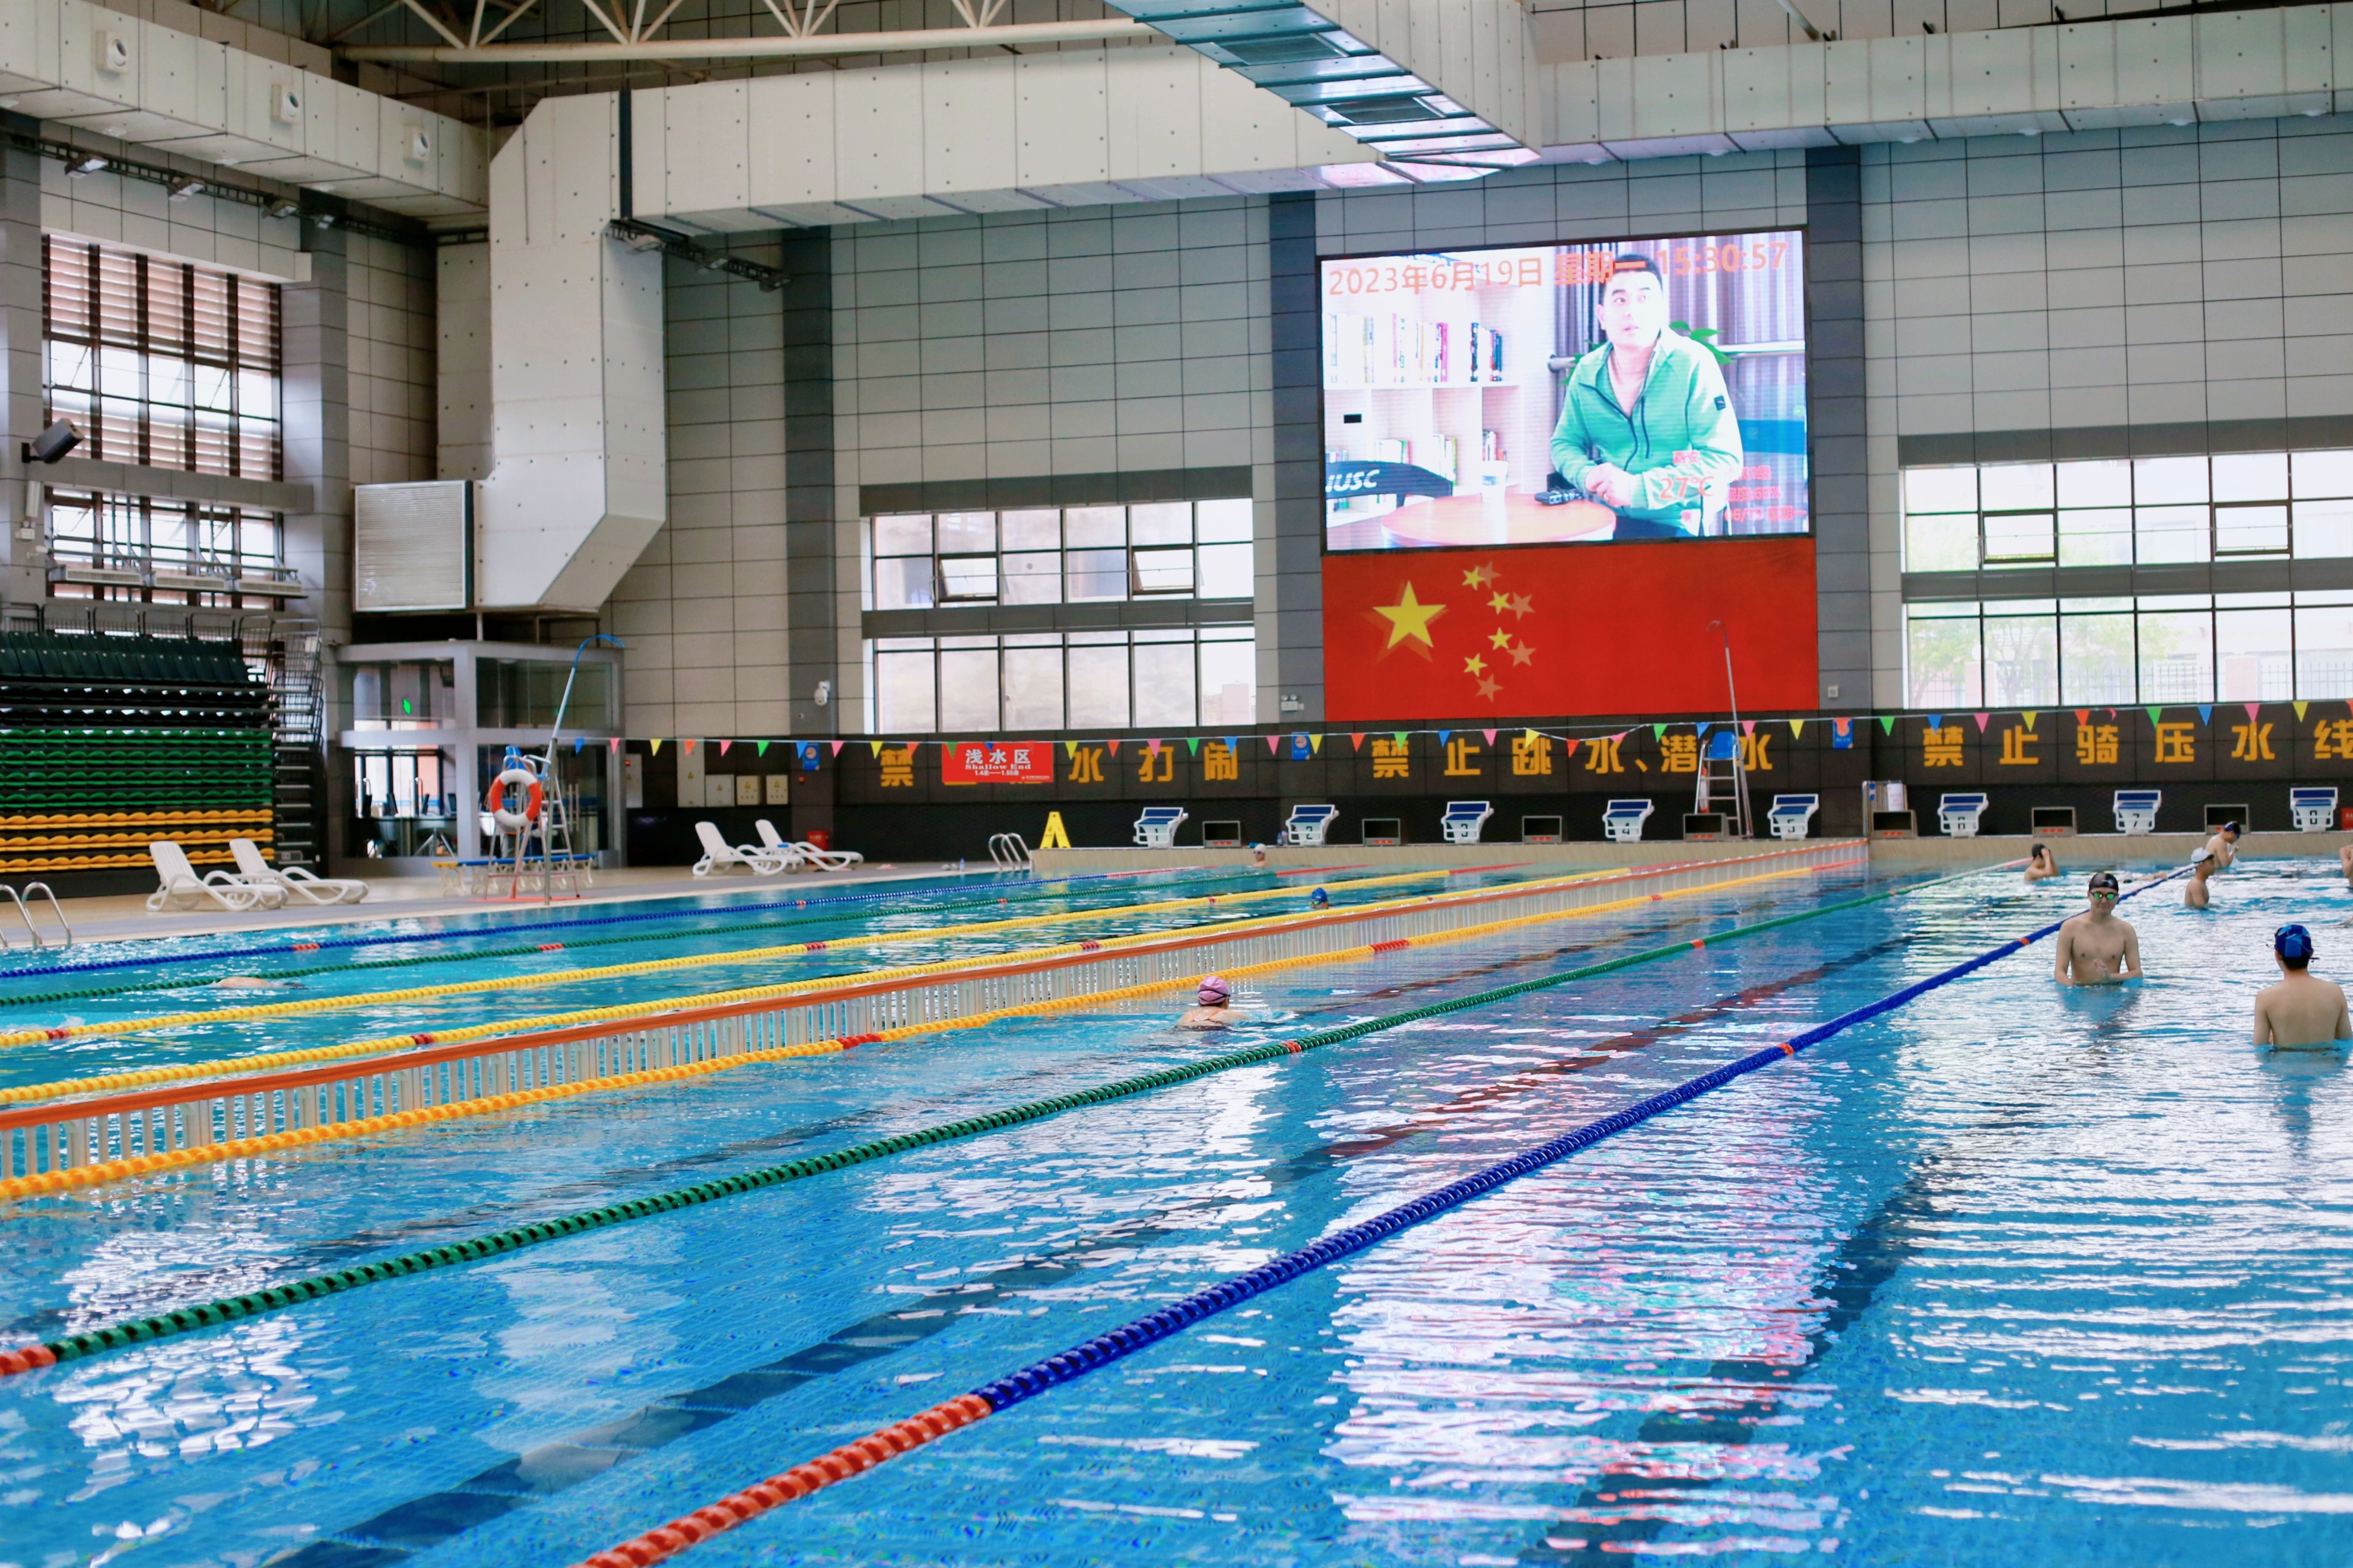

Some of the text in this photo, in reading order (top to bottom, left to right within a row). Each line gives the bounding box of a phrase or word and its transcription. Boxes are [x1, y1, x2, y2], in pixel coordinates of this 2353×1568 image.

[1329, 241, 1787, 295] 2023年6月19日 星期一 15:30:57
[966, 749, 1031, 764] 浅水区
[1787, 819, 1795, 832] 5
[2132, 813, 2139, 827] 7
[1155, 828, 1158, 841] 1
[1306, 826, 1313, 839] 2
[1461, 823, 1468, 837] 3
[1622, 823, 1630, 835] 4
